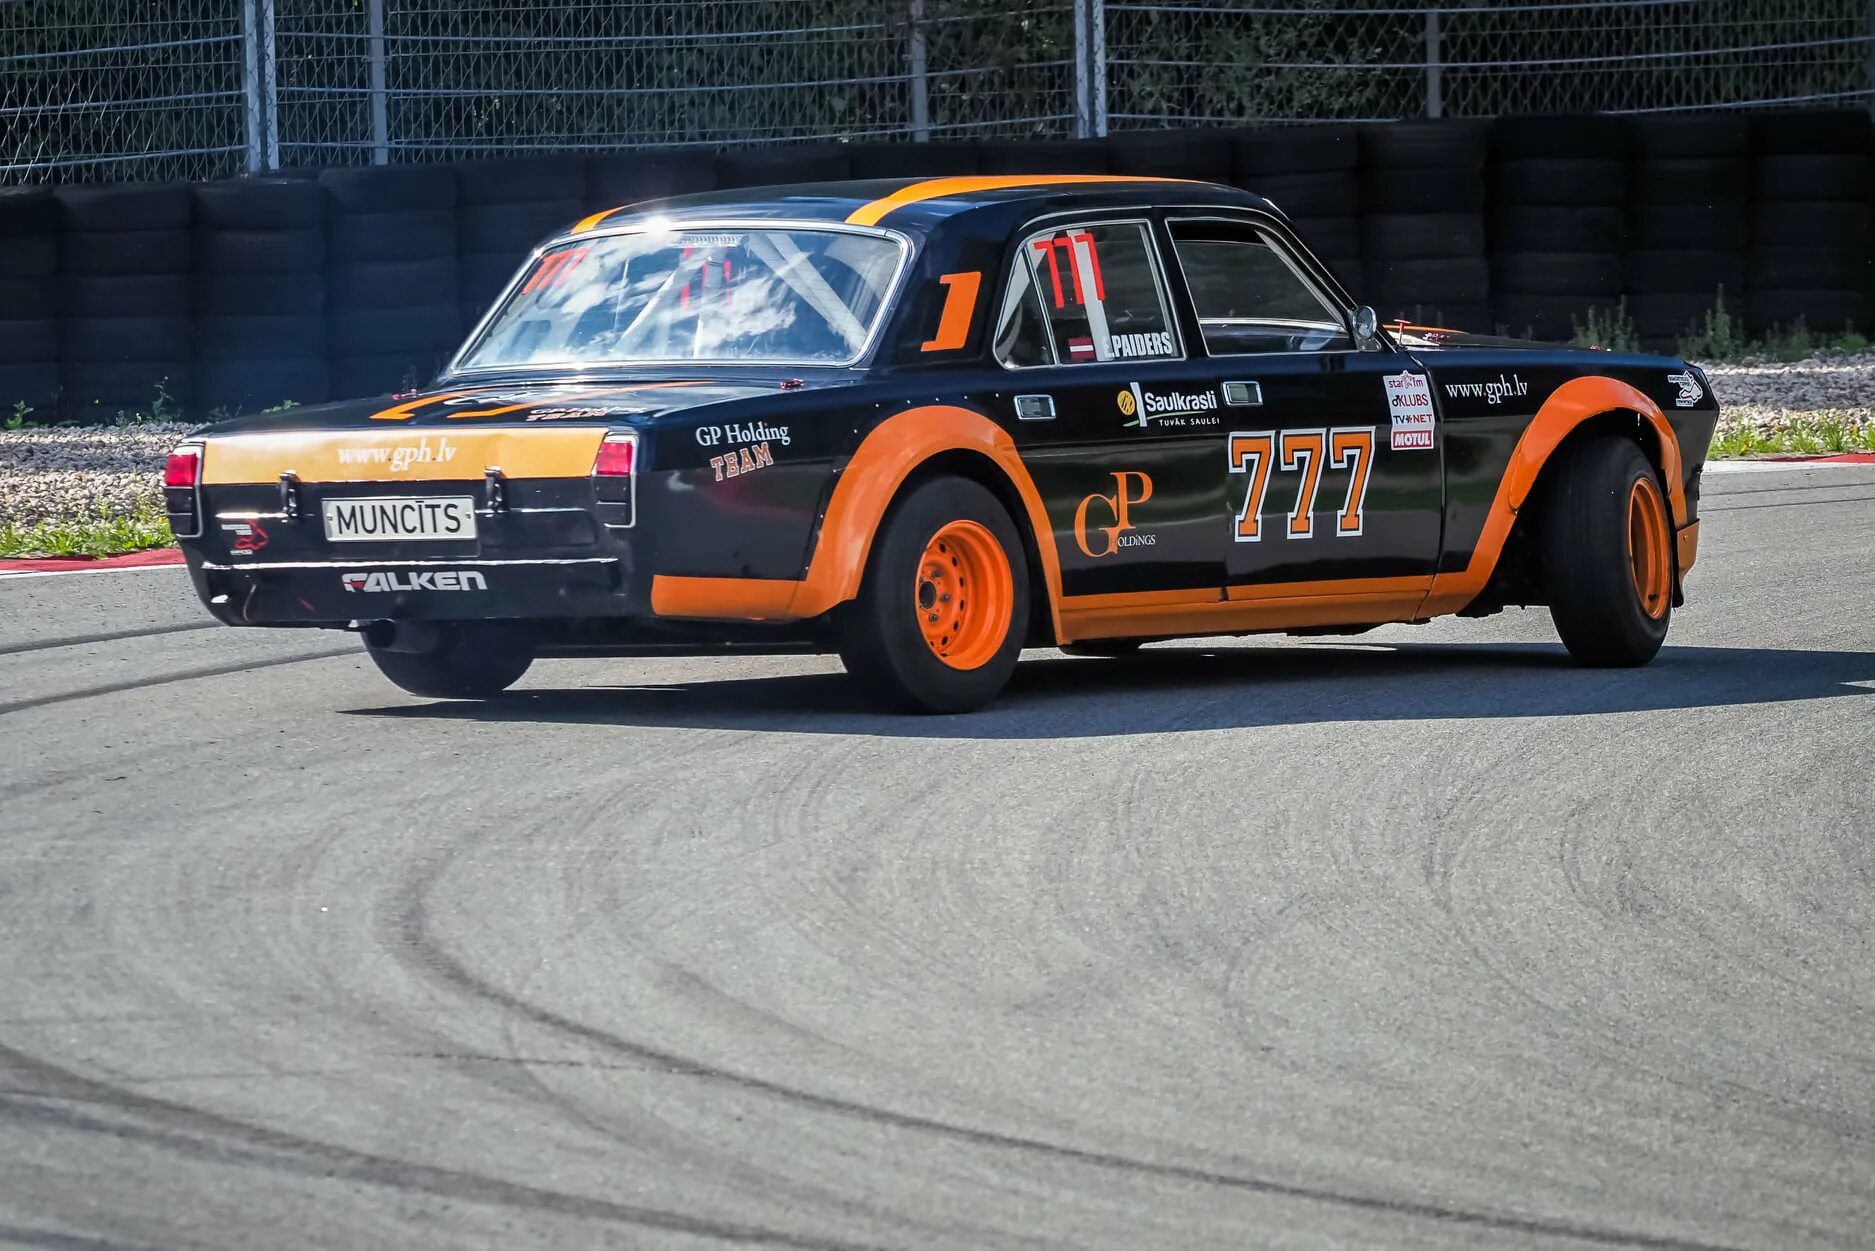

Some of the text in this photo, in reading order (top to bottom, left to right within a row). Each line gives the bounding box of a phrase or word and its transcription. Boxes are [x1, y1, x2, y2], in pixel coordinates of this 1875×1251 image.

[1033, 232, 1105, 309] 777
[1145, 390, 1218, 412] Saulkrasti
[1399, 393, 1429, 406] KLUBS
[1445, 374, 1528, 405] www.gph.lv
[695, 420, 792, 447] GP Holding
[1190, 417, 1220, 426] SAULEI
[337, 437, 457, 472] www.gph.lv
[1394, 432, 1431, 446] MOTUL
[709, 442, 775, 483] TEAM
[1228, 425, 1377, 543] 777
[336, 500, 462, 535] MUNCĪTS
[1074, 471, 1153, 557] GP
[342, 569, 489, 593] FALKEN
